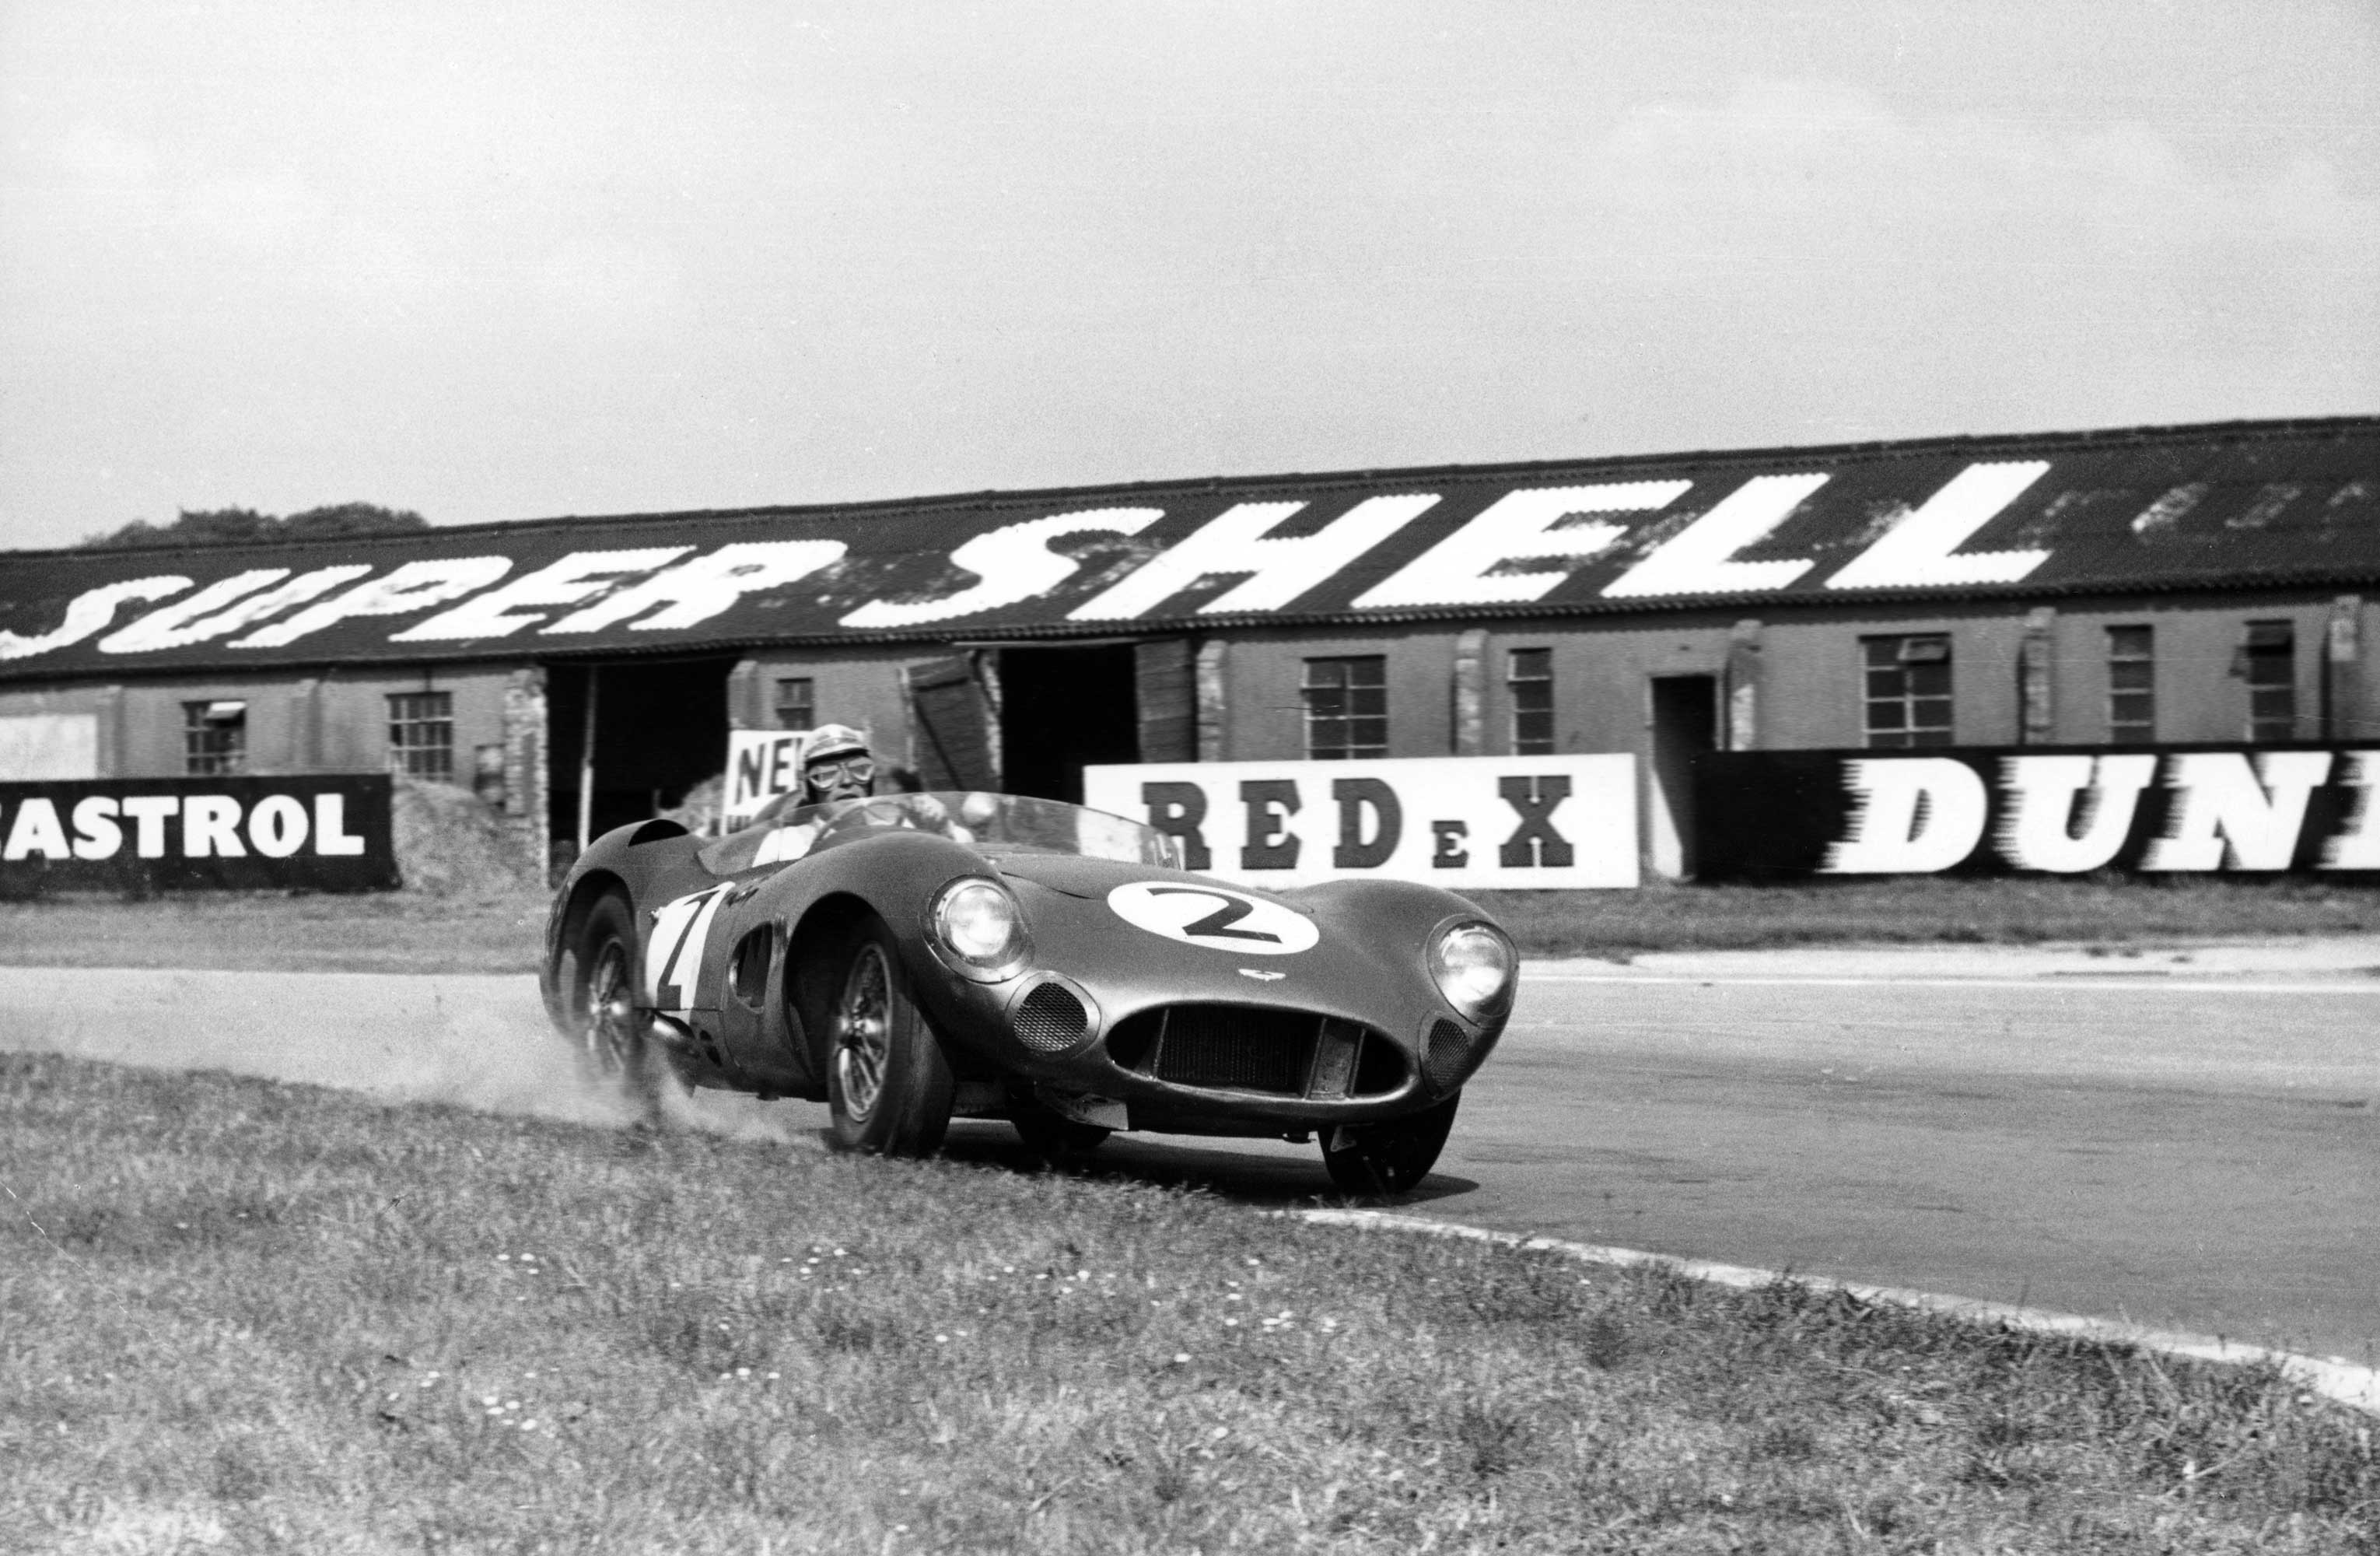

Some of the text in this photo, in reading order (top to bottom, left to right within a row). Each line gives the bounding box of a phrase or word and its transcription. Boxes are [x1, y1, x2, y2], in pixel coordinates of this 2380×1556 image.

[0, 539, 848, 660] SUPER
[838, 460, 2054, 628] SHELL
[734, 738, 804, 805] NE
[0, 794, 365, 860] ASTROL
[1142, 775, 1574, 871] REDEX
[1146, 887, 1283, 944] 2
